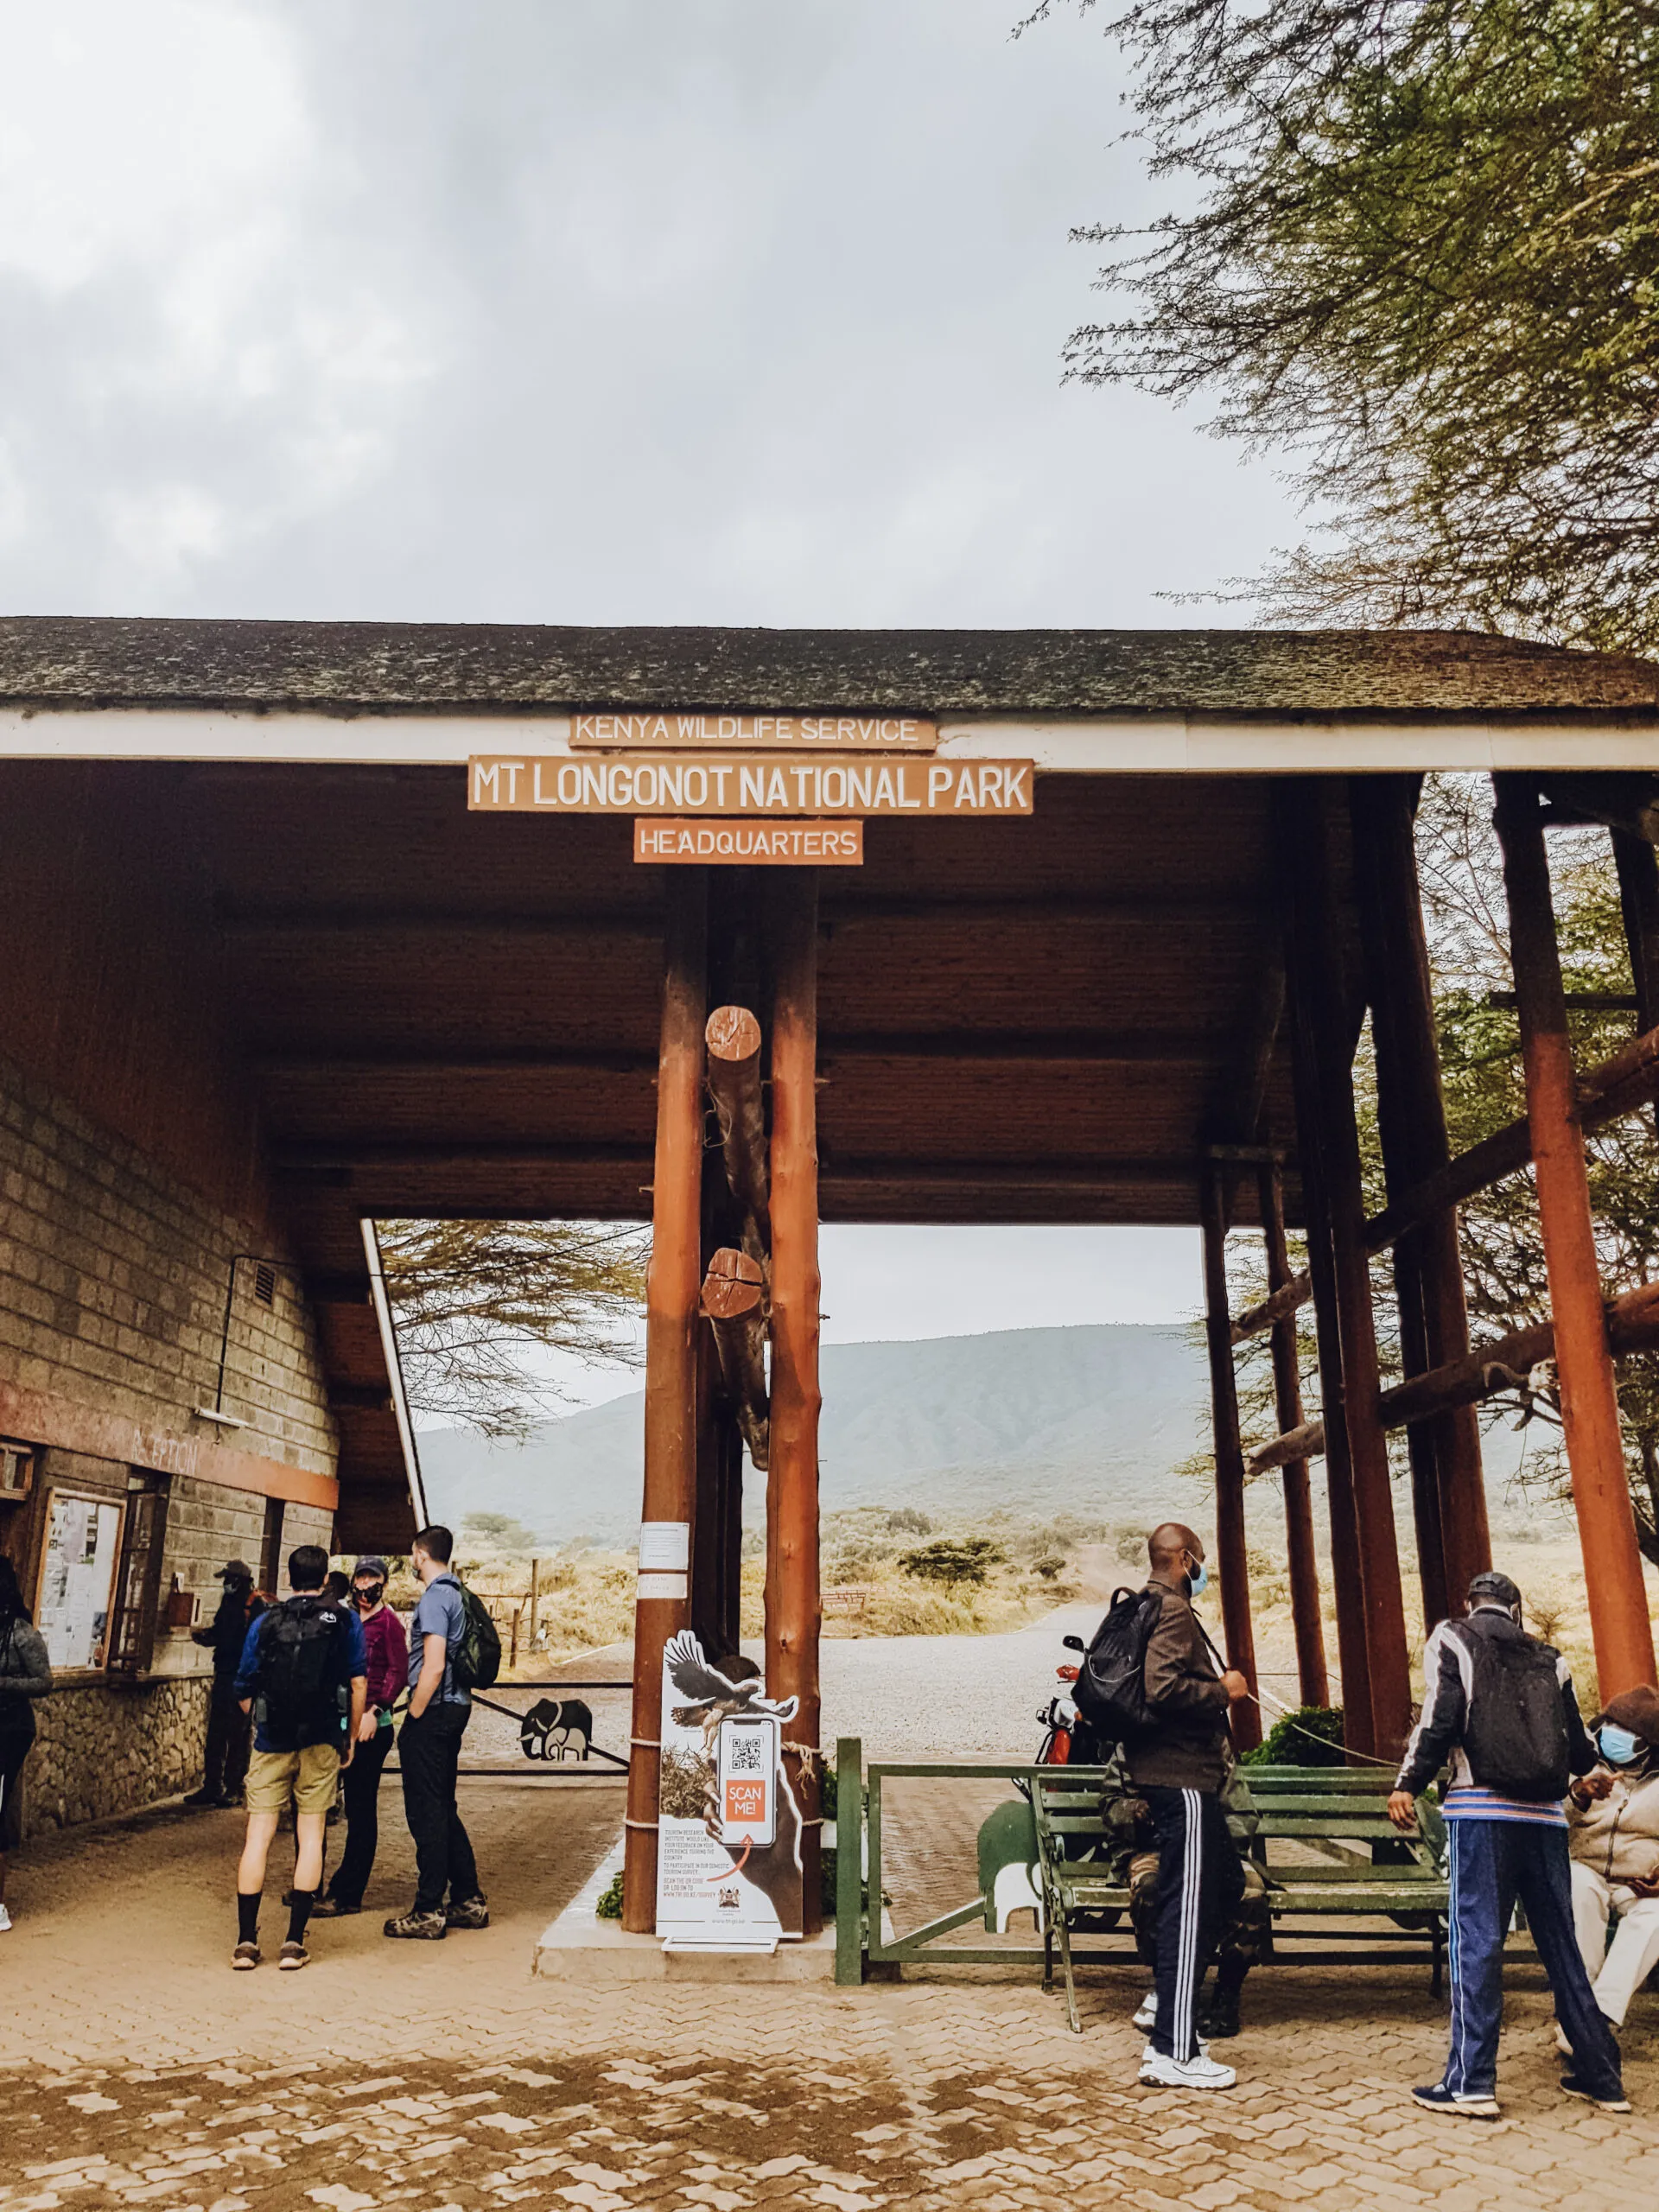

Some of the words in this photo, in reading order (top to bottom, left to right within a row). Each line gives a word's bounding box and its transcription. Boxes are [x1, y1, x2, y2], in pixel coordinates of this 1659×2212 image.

[575, 716, 670, 740] KENYA
[677, 717, 793, 741] WILDLIFE
[800, 718, 918, 741] SERVICE
[473, 763, 524, 804] MT
[533, 764, 733, 807] LONGONOT
[739, 766, 920, 808] NATIONAL
[928, 767, 1028, 809] PARK
[639, 830, 857, 855] HEADQUARTERS
[728, 1786, 761, 1801] SCAN
[734, 1802, 756, 1815] ME!
